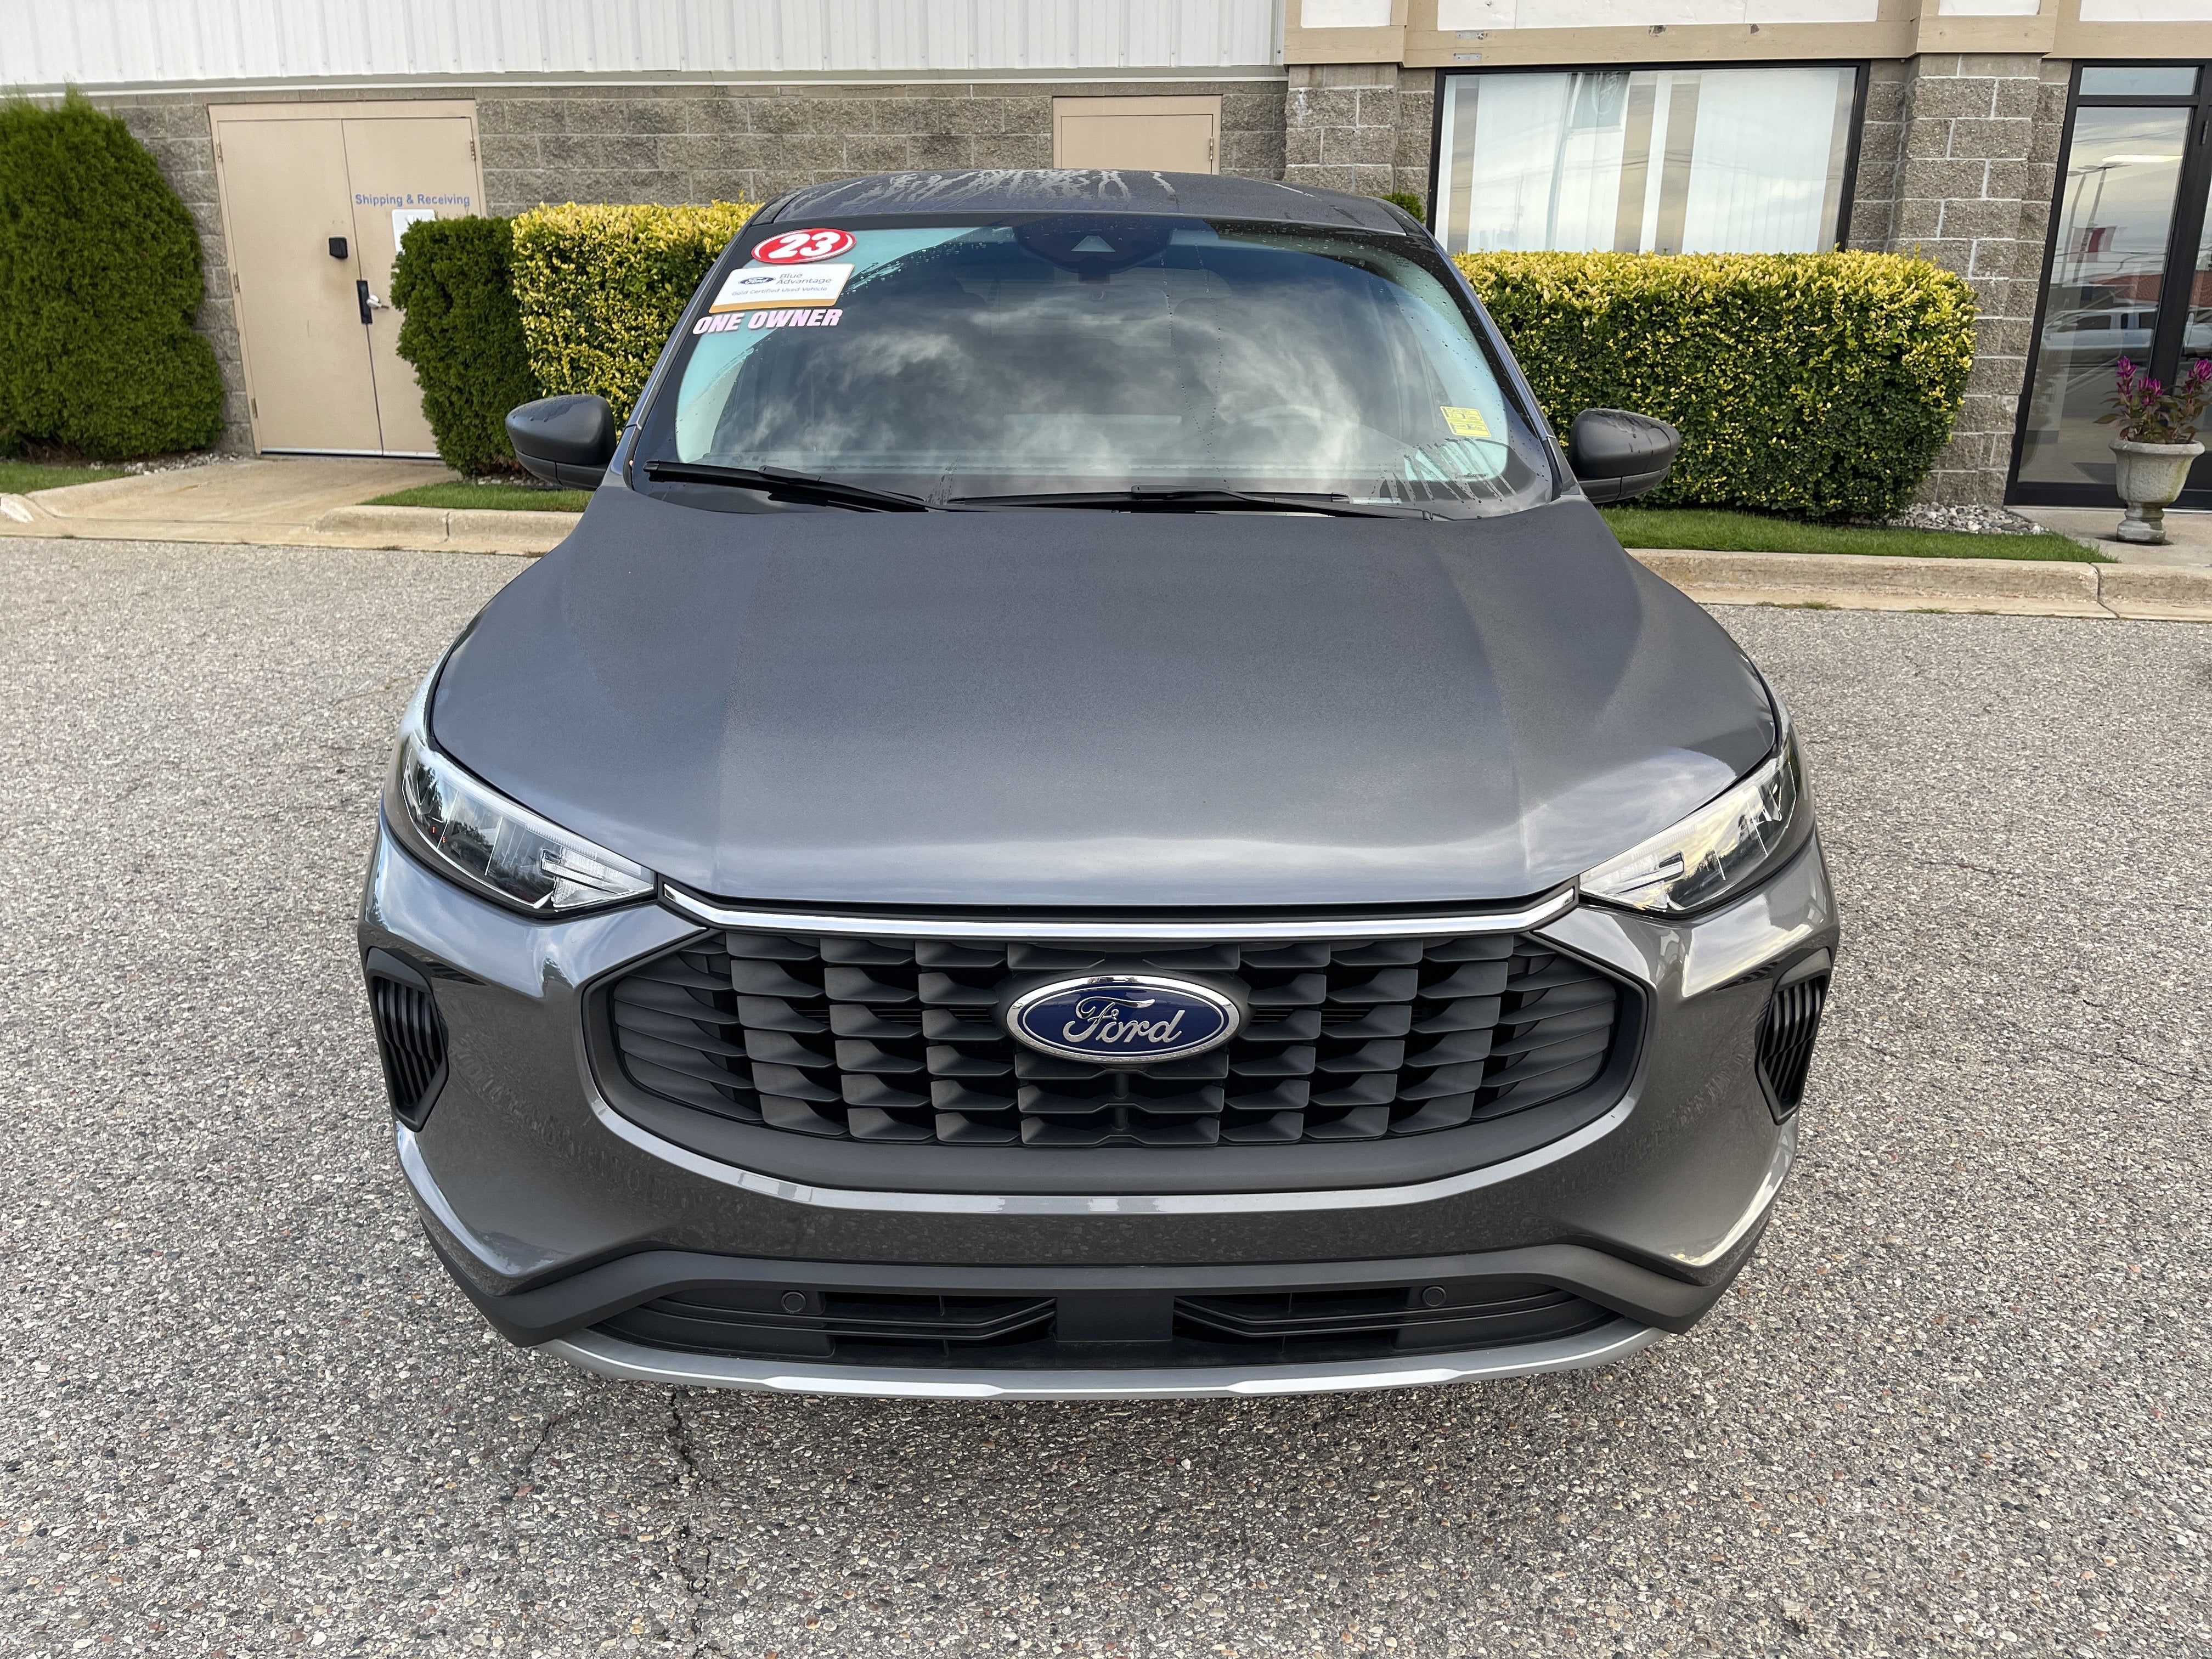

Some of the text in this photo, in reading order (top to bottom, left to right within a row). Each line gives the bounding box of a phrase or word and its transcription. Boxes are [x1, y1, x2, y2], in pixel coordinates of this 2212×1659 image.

[356, 194, 470, 206] Shipping & Receiving
[769, 231, 841, 258] 23
[692, 309, 843, 335] ONE OWNER
[1063, 996, 1185, 1043] Ford
